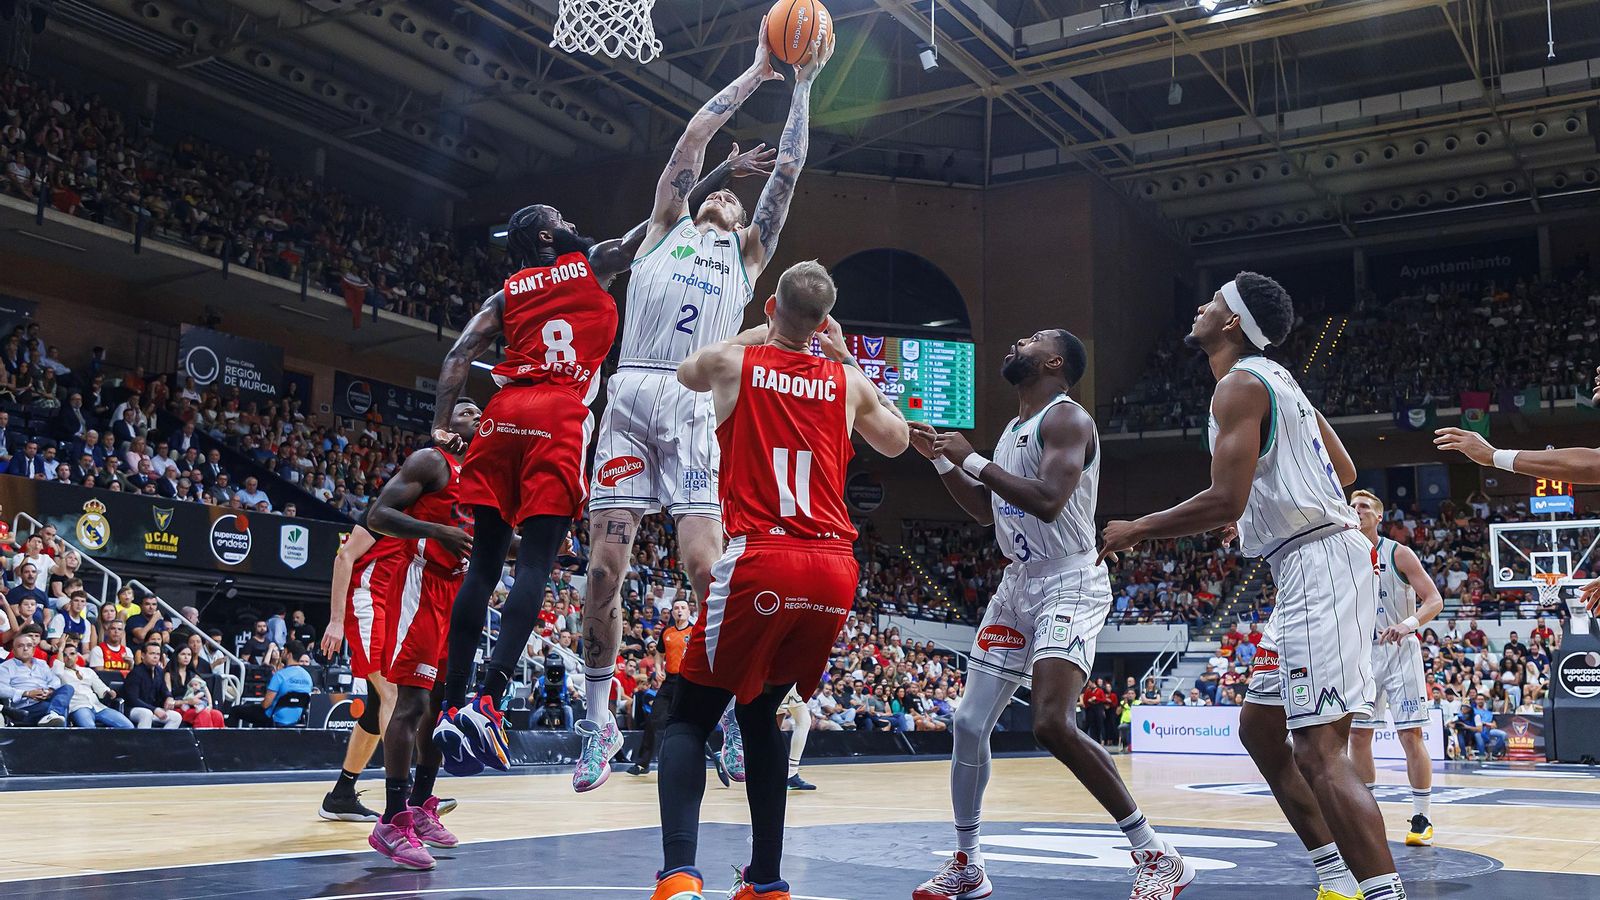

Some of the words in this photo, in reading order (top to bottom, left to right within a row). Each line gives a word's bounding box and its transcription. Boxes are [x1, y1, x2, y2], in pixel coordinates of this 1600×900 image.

[694, 255, 730, 275] unicaja
[509, 262, 588, 295] SANT-ROOS
[672, 272, 721, 296] málaga
[675, 304, 699, 335] 2
[541, 319, 577, 364] 8
[864, 365, 880, 379] 52
[903, 367, 919, 381] 54
[224, 375, 237, 387] DE
[239, 379, 276, 395] MURCIA
[752, 365, 837, 402] RADOVIĆ
[880, 382, 905, 394] 3:20
[528, 429, 552, 439] MURCIA
[1535, 480, 1563, 497] 24
[144, 531, 179, 546] UCAM
[214, 531, 248, 541] supercopa
[216, 539, 248, 549] endesa
[1015, 533, 1032, 562] 3
[784, 602, 812, 610] REGIÓN
[813, 604, 824, 612] DE
[1291, 671, 1305, 679] acb
[1155, 725, 1231, 739] quirónsalud
